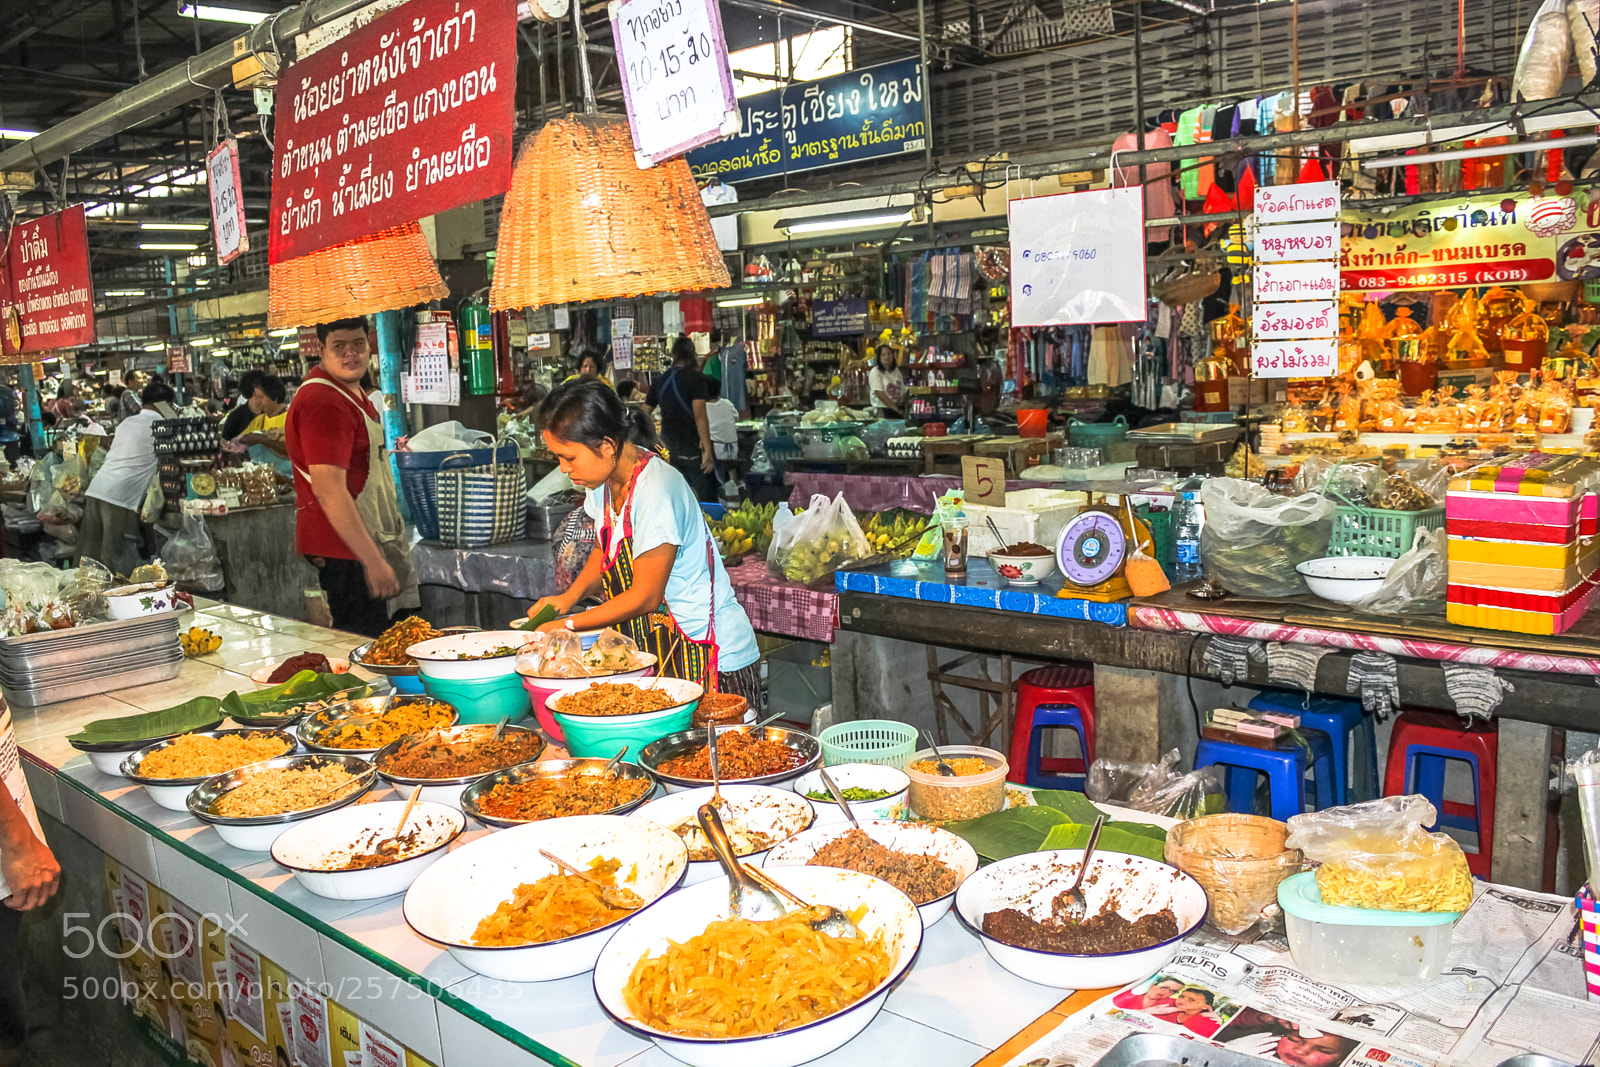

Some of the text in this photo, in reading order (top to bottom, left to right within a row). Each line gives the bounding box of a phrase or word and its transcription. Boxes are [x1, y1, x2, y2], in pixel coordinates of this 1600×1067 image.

[281, 62, 497, 178] ตำขนุน ตำมะเขือ แกงบอน
[656, 85, 697, 120] บาท
[723, 62, 923, 145] ประตูเชียงใหม่
[281, 123, 491, 235] ยำผัก น้ำเมี่ยง ยำมะเขือ
[1261, 235, 1333, 258] หมูหยอง
[1359, 271, 1468, 288] 083-9482315
[1475, 268, 1528, 284] (KOB)
[975, 463, 993, 498] 5
